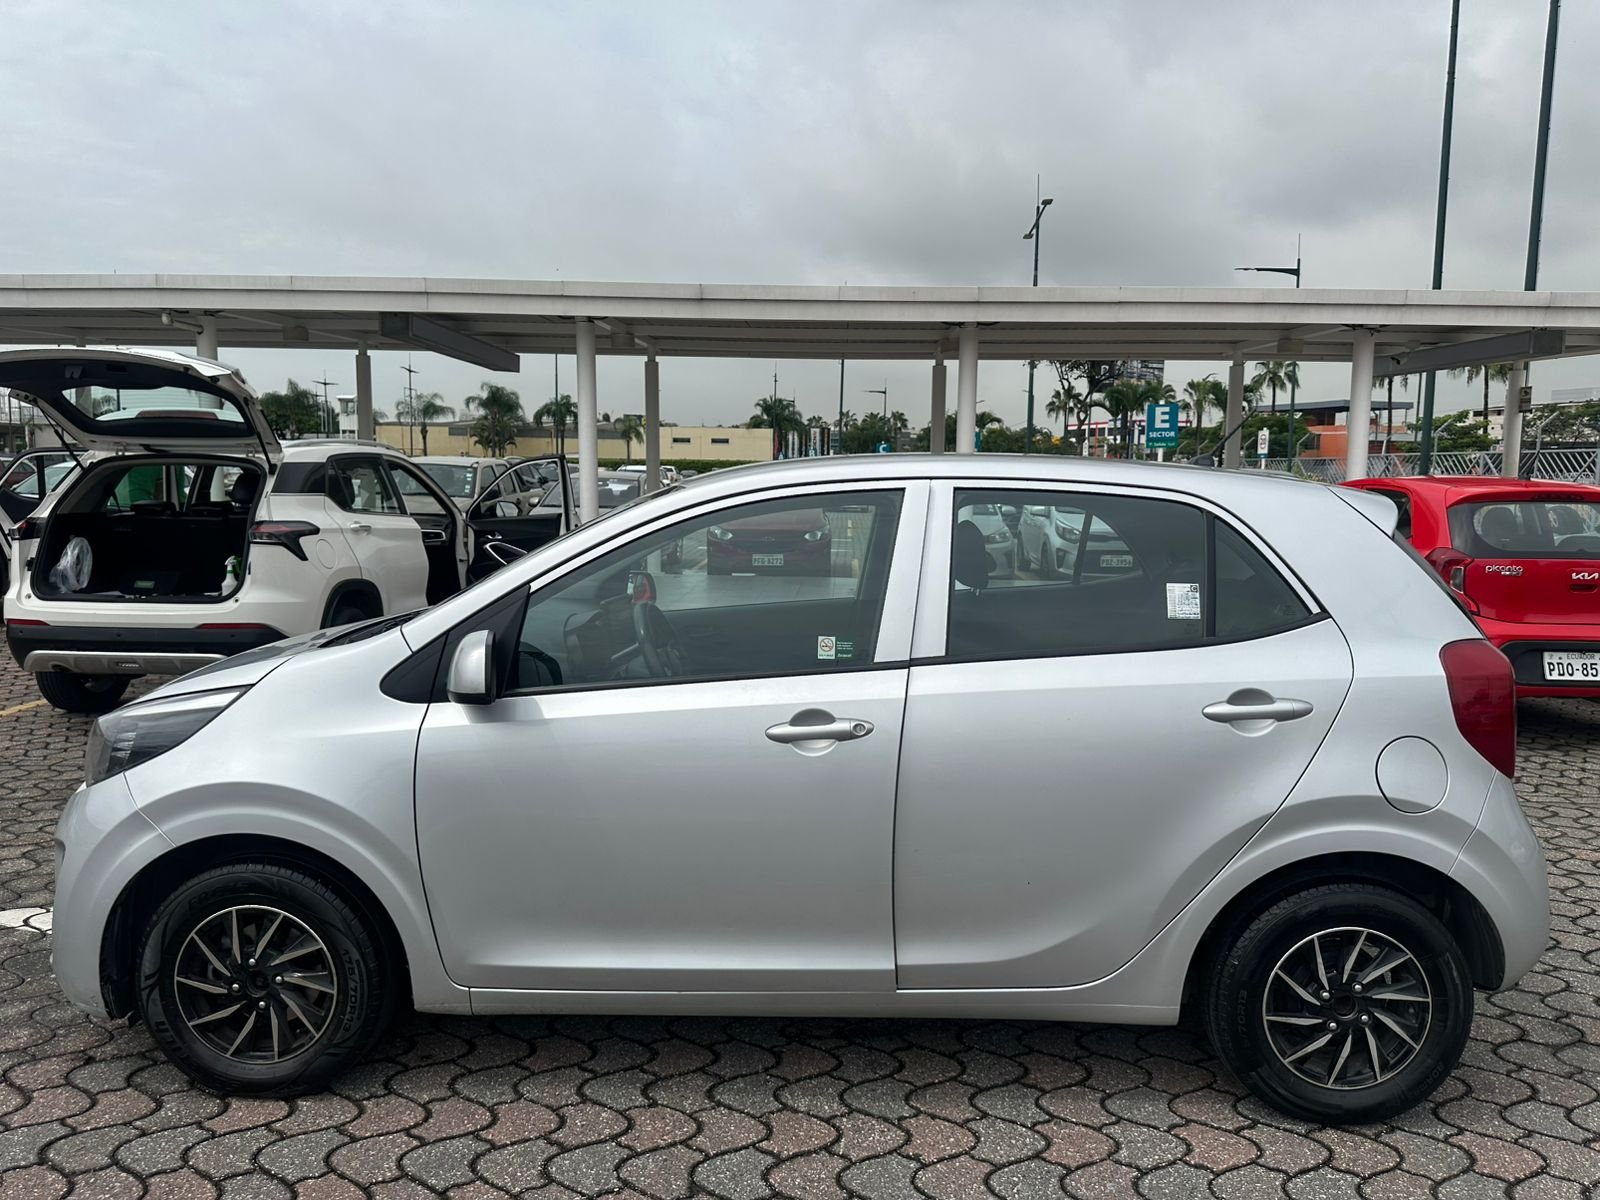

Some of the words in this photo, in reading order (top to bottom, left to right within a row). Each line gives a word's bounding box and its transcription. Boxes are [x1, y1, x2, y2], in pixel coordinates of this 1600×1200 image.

[1154, 406, 1170, 428] E
[1485, 564, 1523, 574] picanto
[1571, 572, 1599, 580] KIA
[1547, 661, 1599, 678] PDO-85
